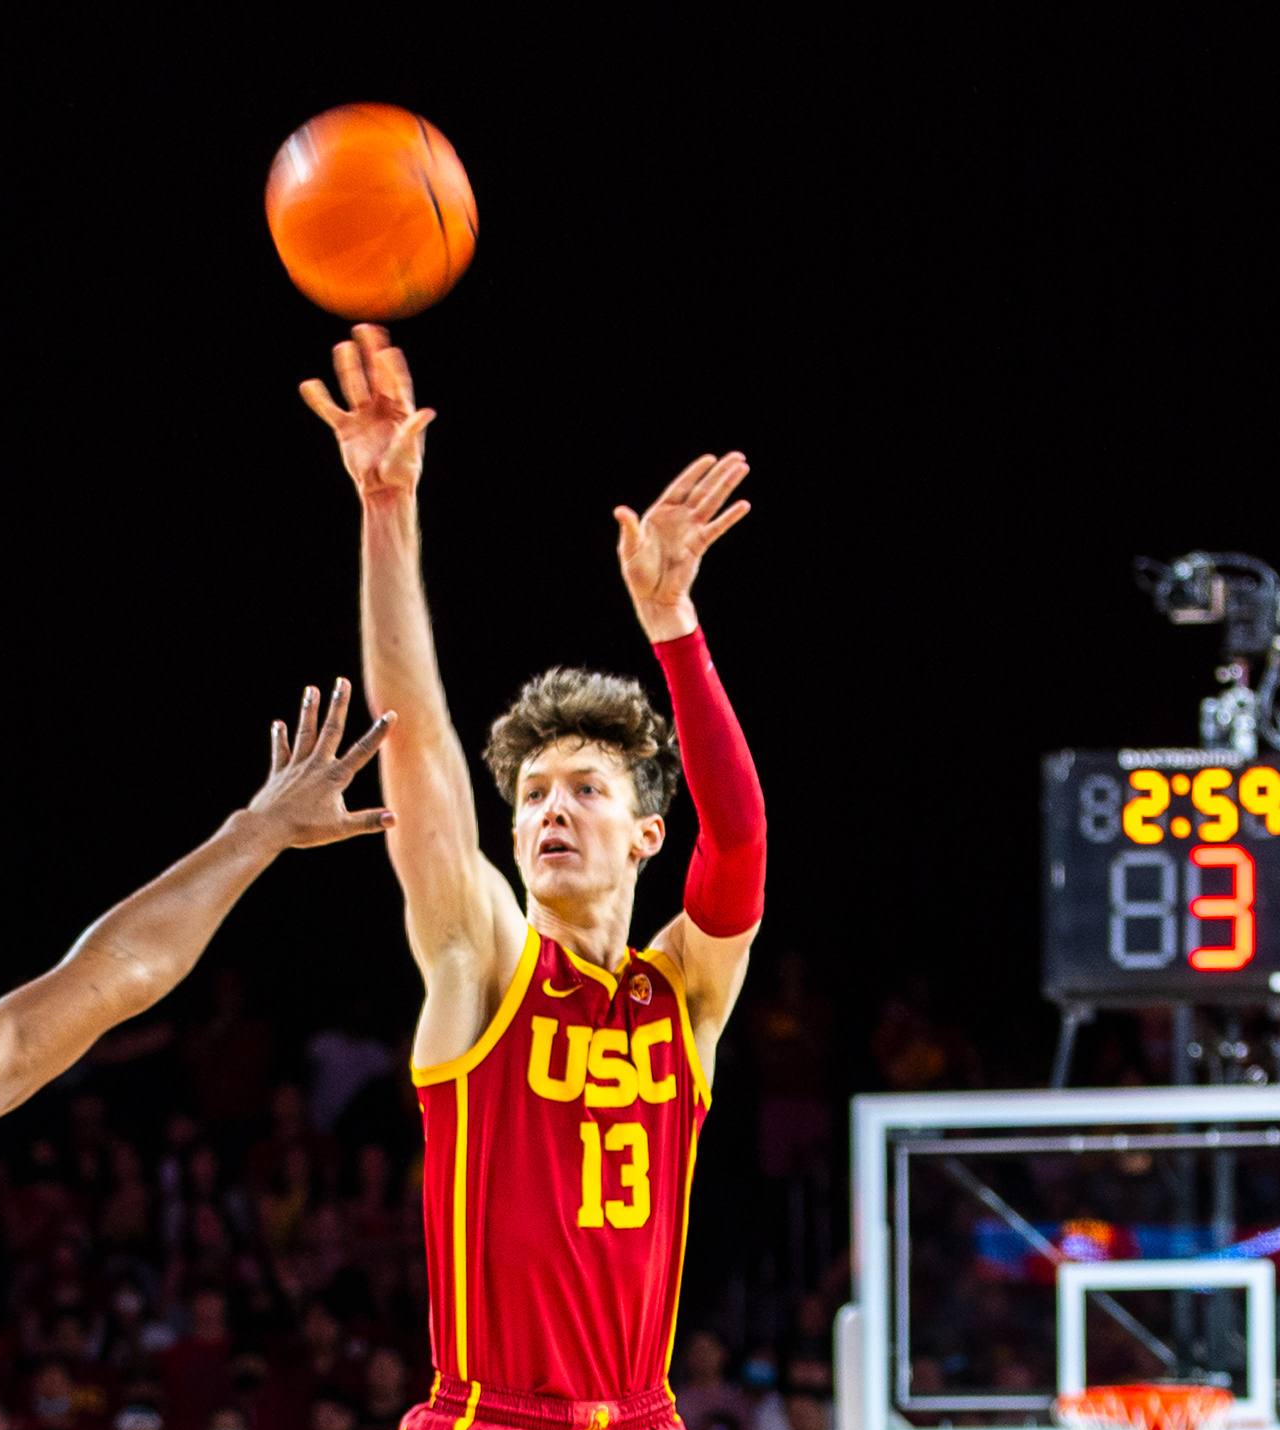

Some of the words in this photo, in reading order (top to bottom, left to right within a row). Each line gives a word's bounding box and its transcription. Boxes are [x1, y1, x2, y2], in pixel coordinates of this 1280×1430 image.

[1189, 844, 1256, 972] 3
[527, 1015, 677, 1108] USC
[577, 1122, 651, 1229] 13
